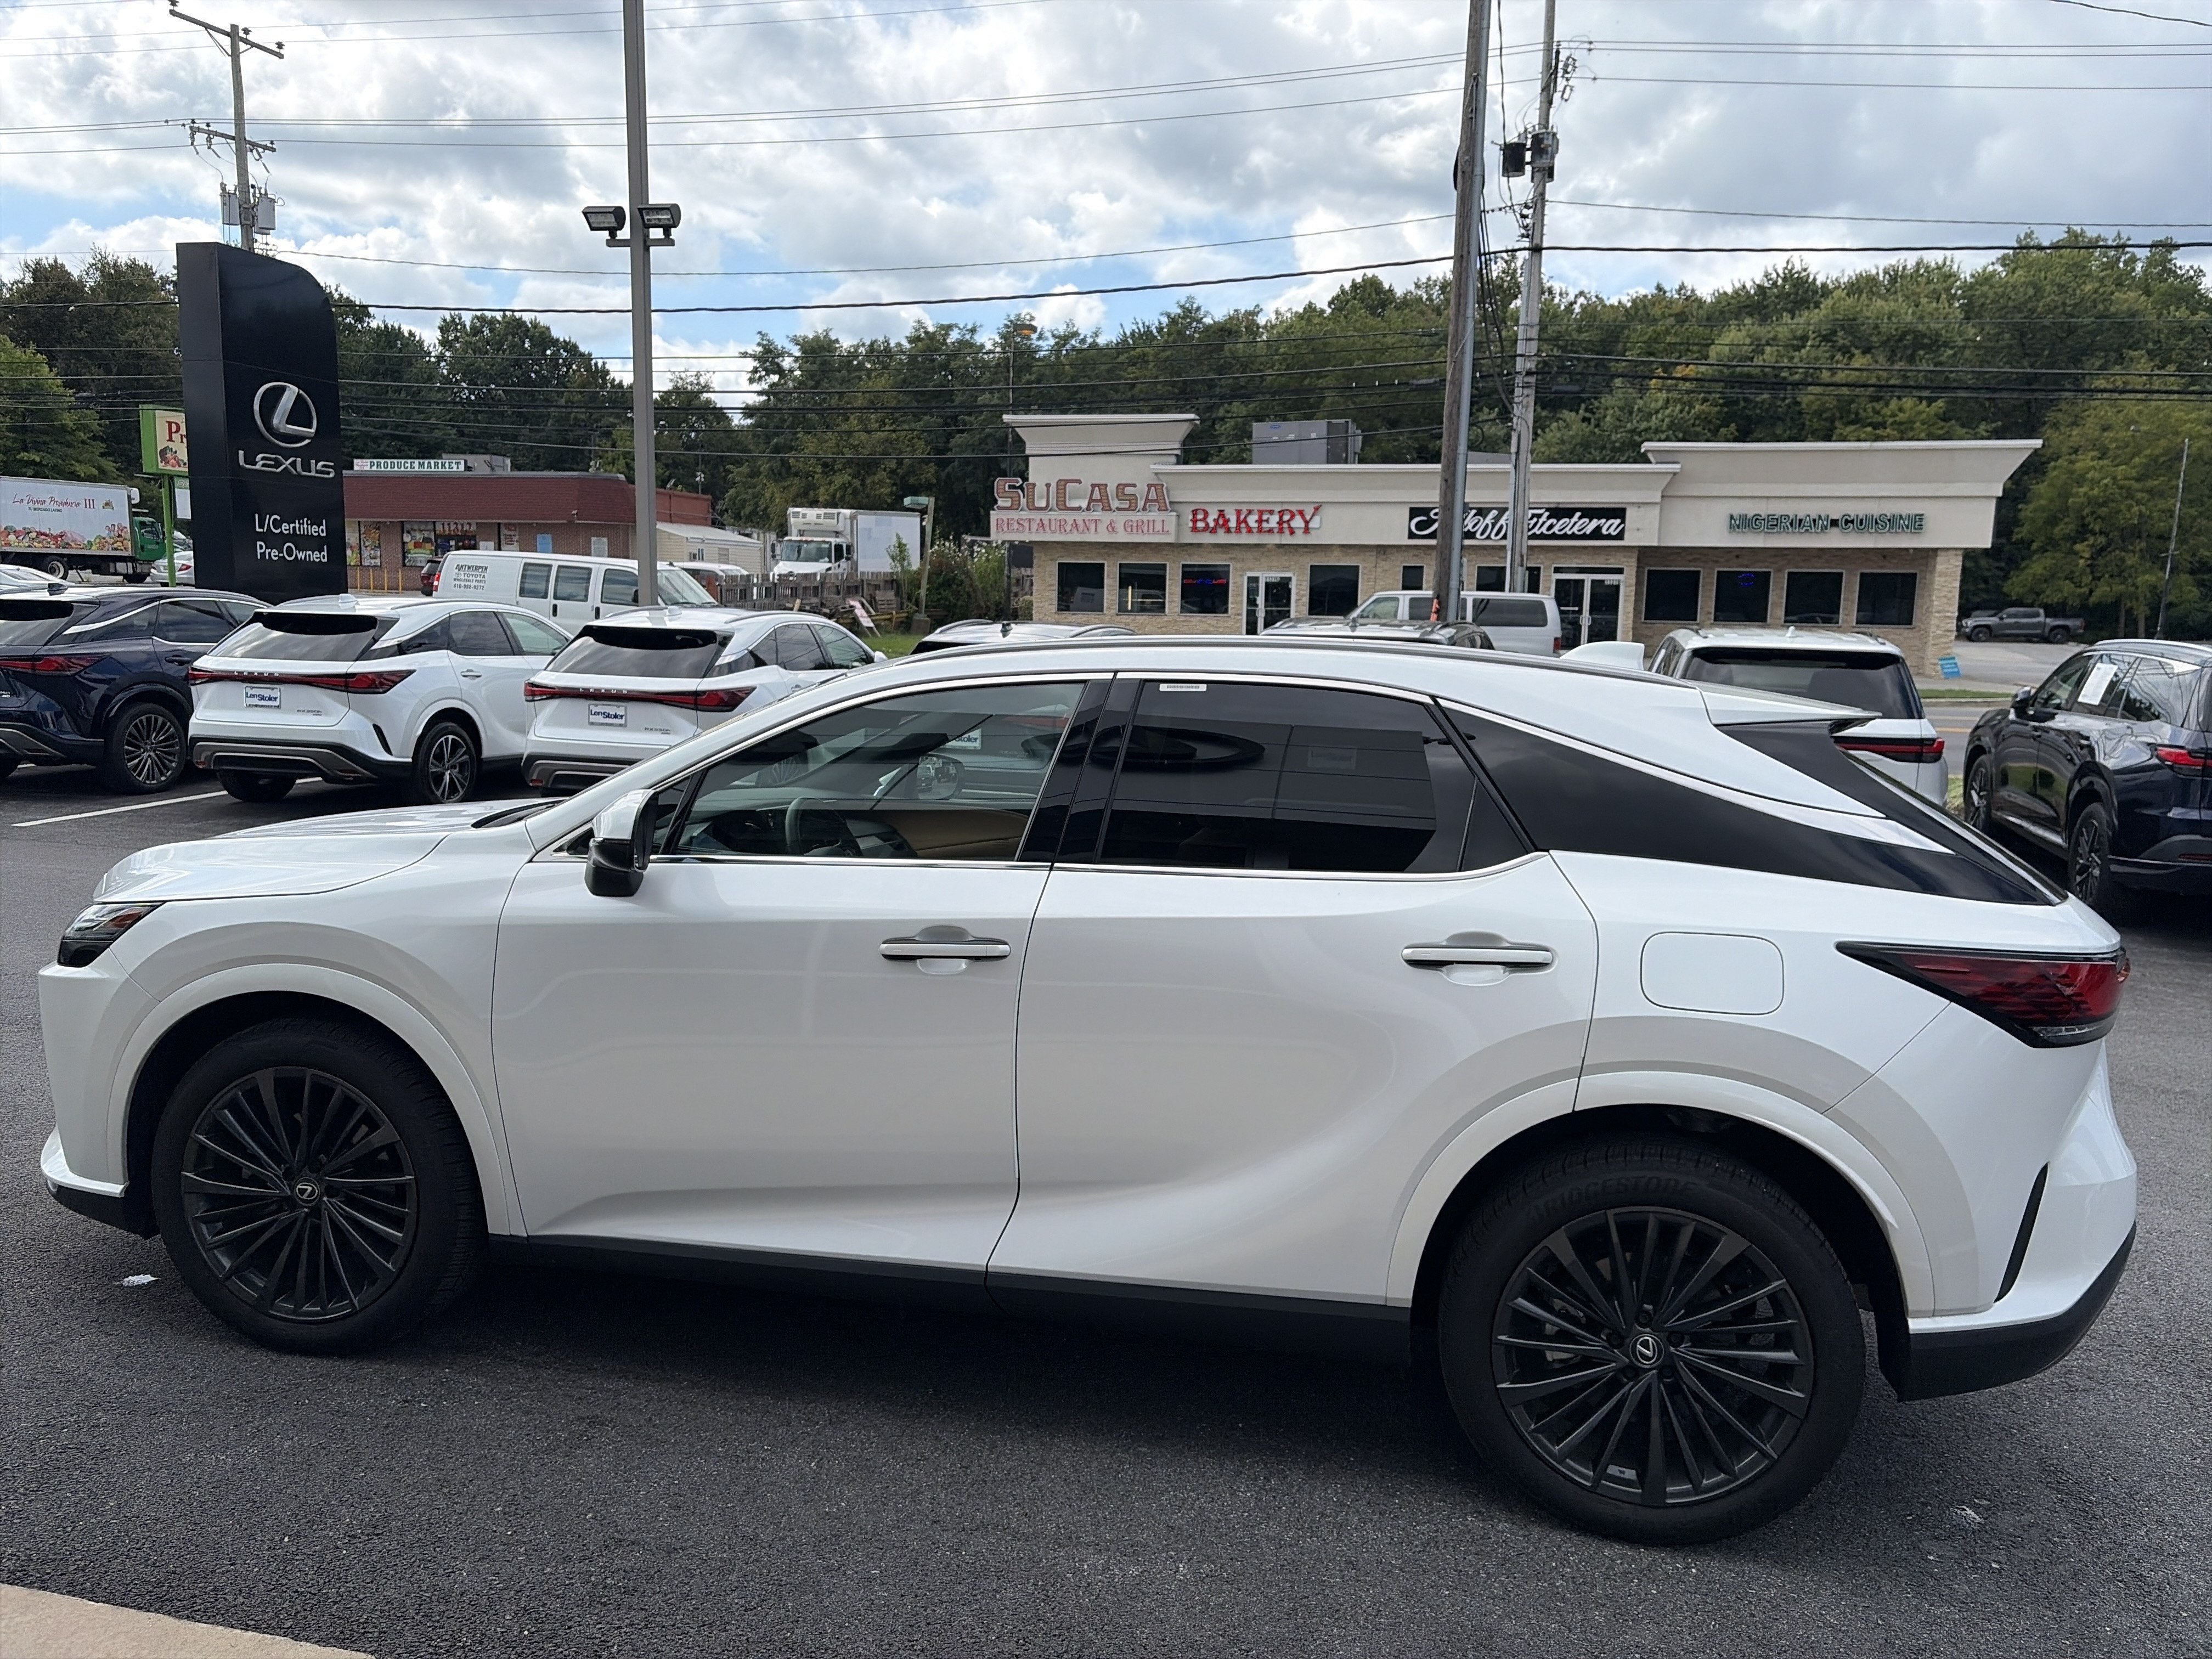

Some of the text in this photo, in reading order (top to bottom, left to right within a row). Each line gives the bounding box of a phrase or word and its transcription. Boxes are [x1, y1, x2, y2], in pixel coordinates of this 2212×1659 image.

[238, 450, 335, 478] LEXUS
[369, 461, 415, 470] PRODUCE
[417, 461, 461, 470] MARKET
[12, 493, 95, 509] La Divina Providencia III
[255, 514, 326, 537] L/Certified
[995, 517, 1171, 534] RESTAURANT & GRILL
[1190, 504, 1322, 535] BAKERY
[1728, 512, 1926, 533] NIGERIAN CUISINE
[256, 541, 328, 562] Pre-Owned
